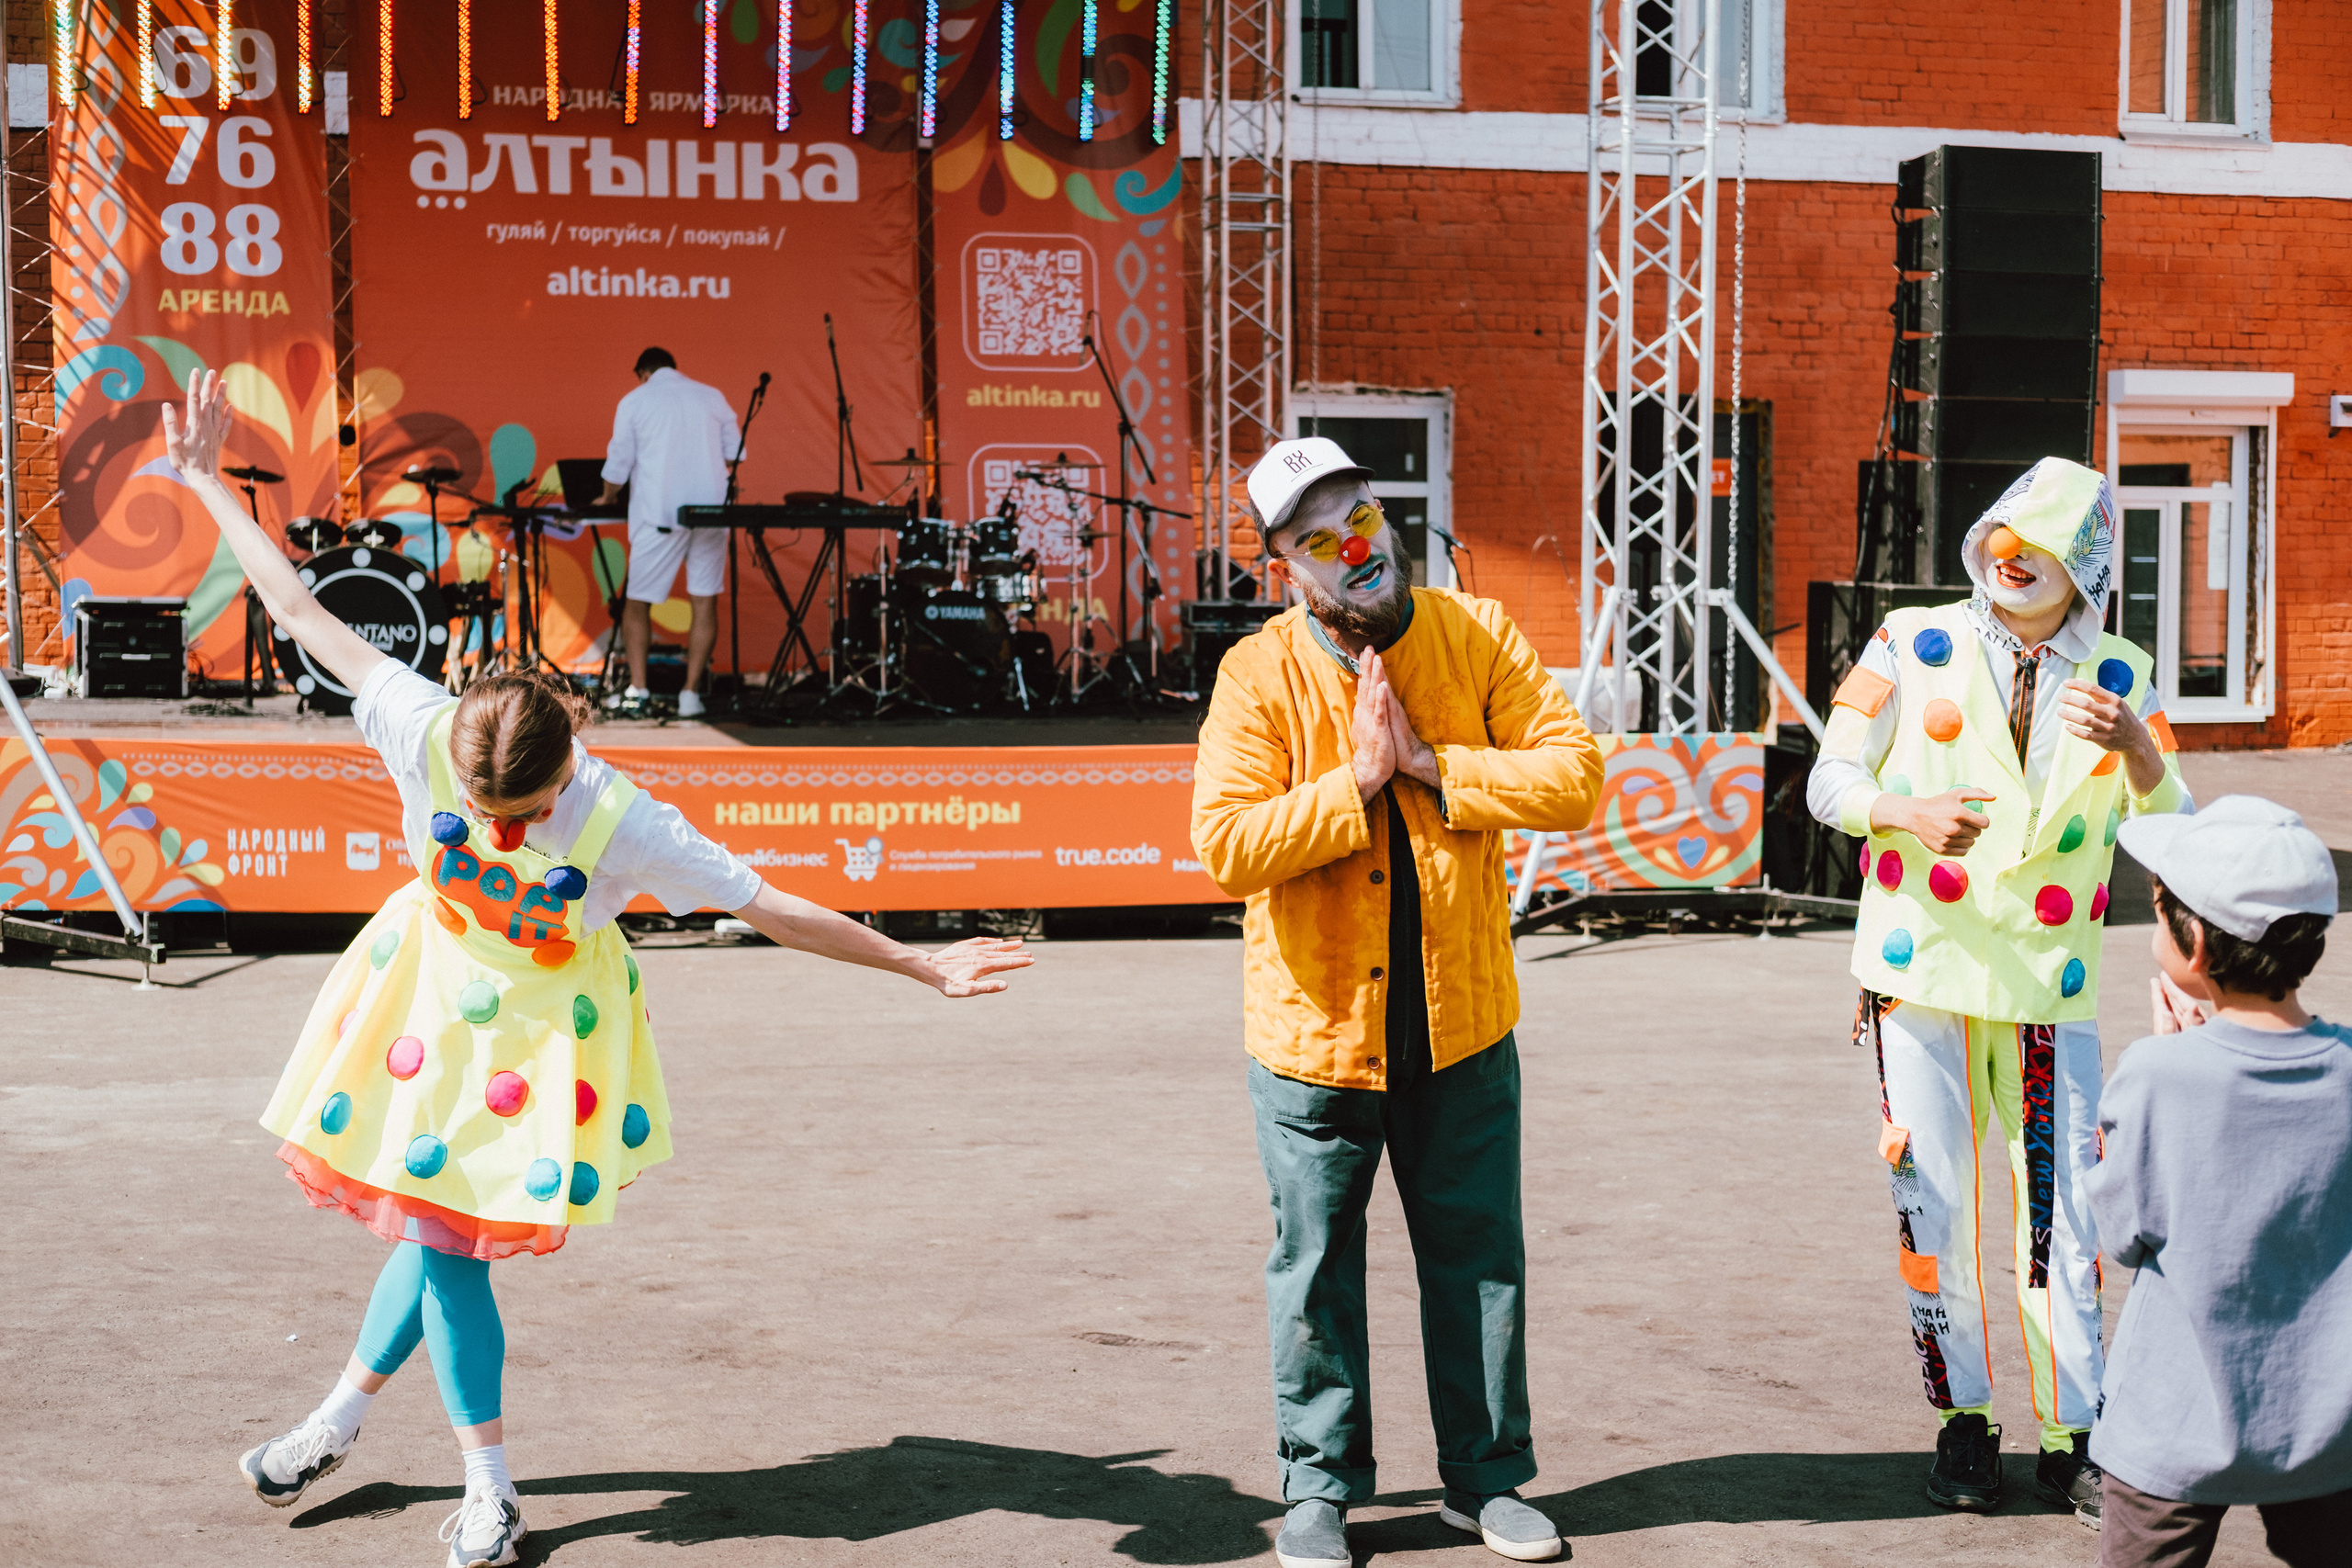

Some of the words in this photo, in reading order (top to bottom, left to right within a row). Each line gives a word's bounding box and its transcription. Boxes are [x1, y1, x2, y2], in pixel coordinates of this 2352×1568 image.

[153, 25, 277, 101] 69
[492, 85, 634, 113] НАРДНА
[159, 115, 276, 189] 76
[160, 201, 283, 276] 88
[487, 222, 546, 245] гуляй
[568, 224, 662, 248] торгуйся
[684, 225, 770, 249] покупай
[547, 266, 730, 299] altinka.ru
[158, 288, 290, 318] АРЕНДА
[967, 384, 1101, 408] altinka.ru
[939, 605, 987, 621] YAMAHA
[715, 799, 820, 826] наши
[830, 795, 1021, 831] партнёры
[228, 827, 325, 853] НАРОДНЫЙ
[1056, 842, 1161, 866] true.code
[228, 855, 288, 878] ФРОНТ
[437, 847, 564, 914] POP
[508, 910, 562, 940] IT
